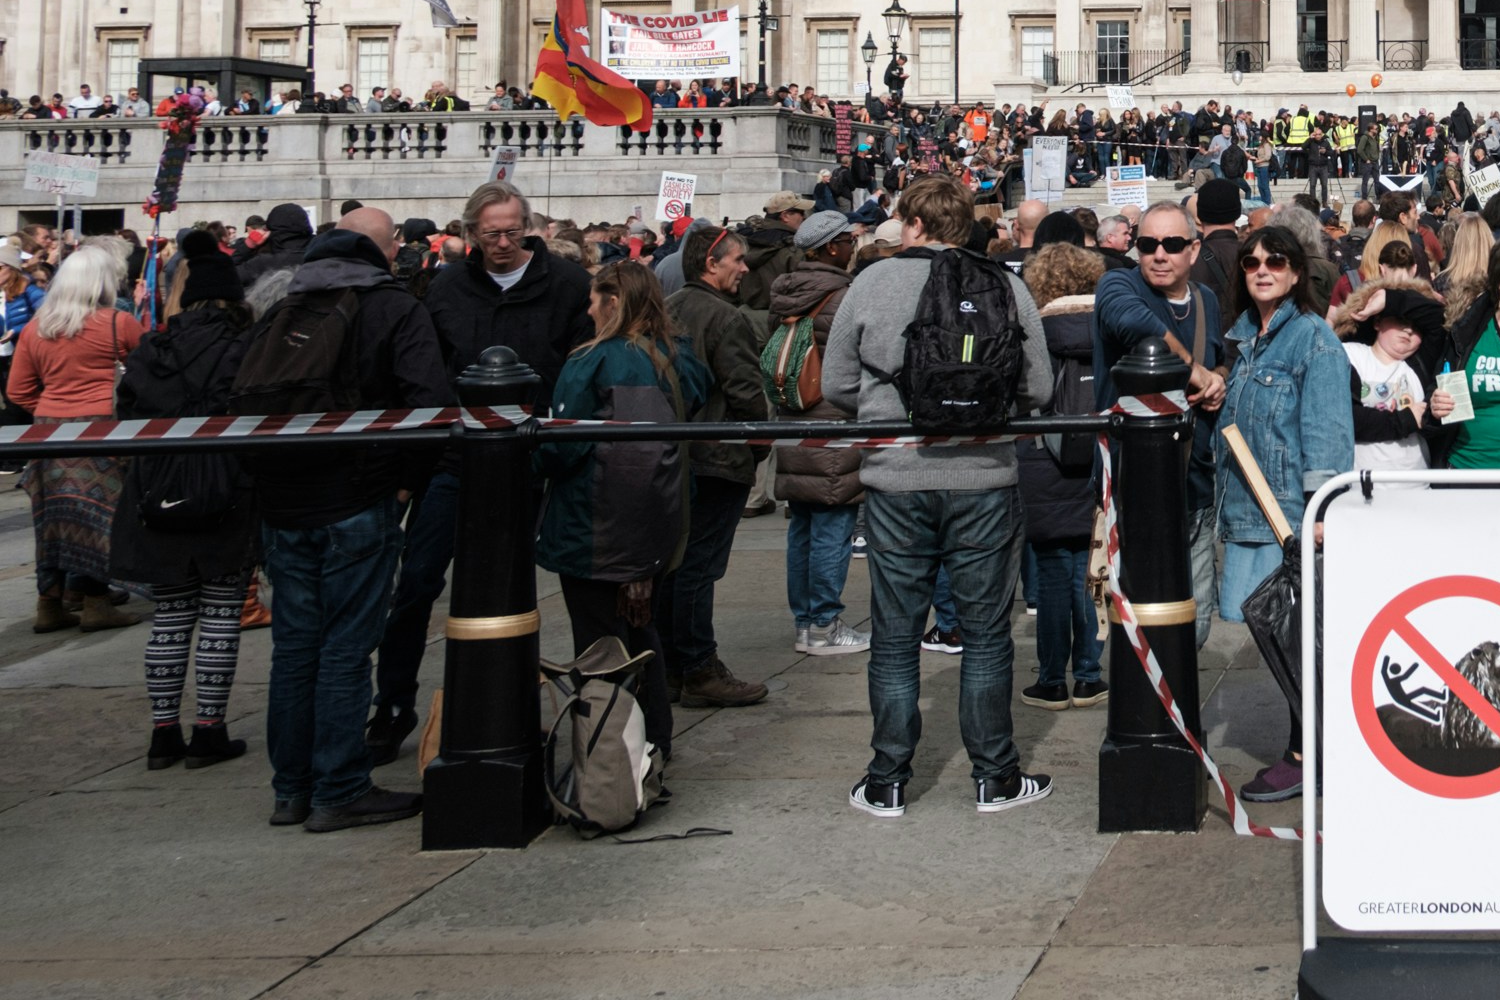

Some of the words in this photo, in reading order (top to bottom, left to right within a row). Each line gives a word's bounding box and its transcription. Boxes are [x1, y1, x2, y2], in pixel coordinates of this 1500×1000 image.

[610, 11, 640, 26] THE
[643, 16, 698, 28] COVID
[702, 9, 729, 24] LIE
[634, 29, 652, 39] JAIL
[653, 31, 671, 40] BILL
[672, 30, 699, 39] GATES
[630, 42, 650, 51] JAIL
[676, 41, 713, 51] HANCOCK
[1470, 171, 1487, 186] Did
[664, 181, 693, 191] CASHLESS
[662, 188, 692, 200] SOCIETY
